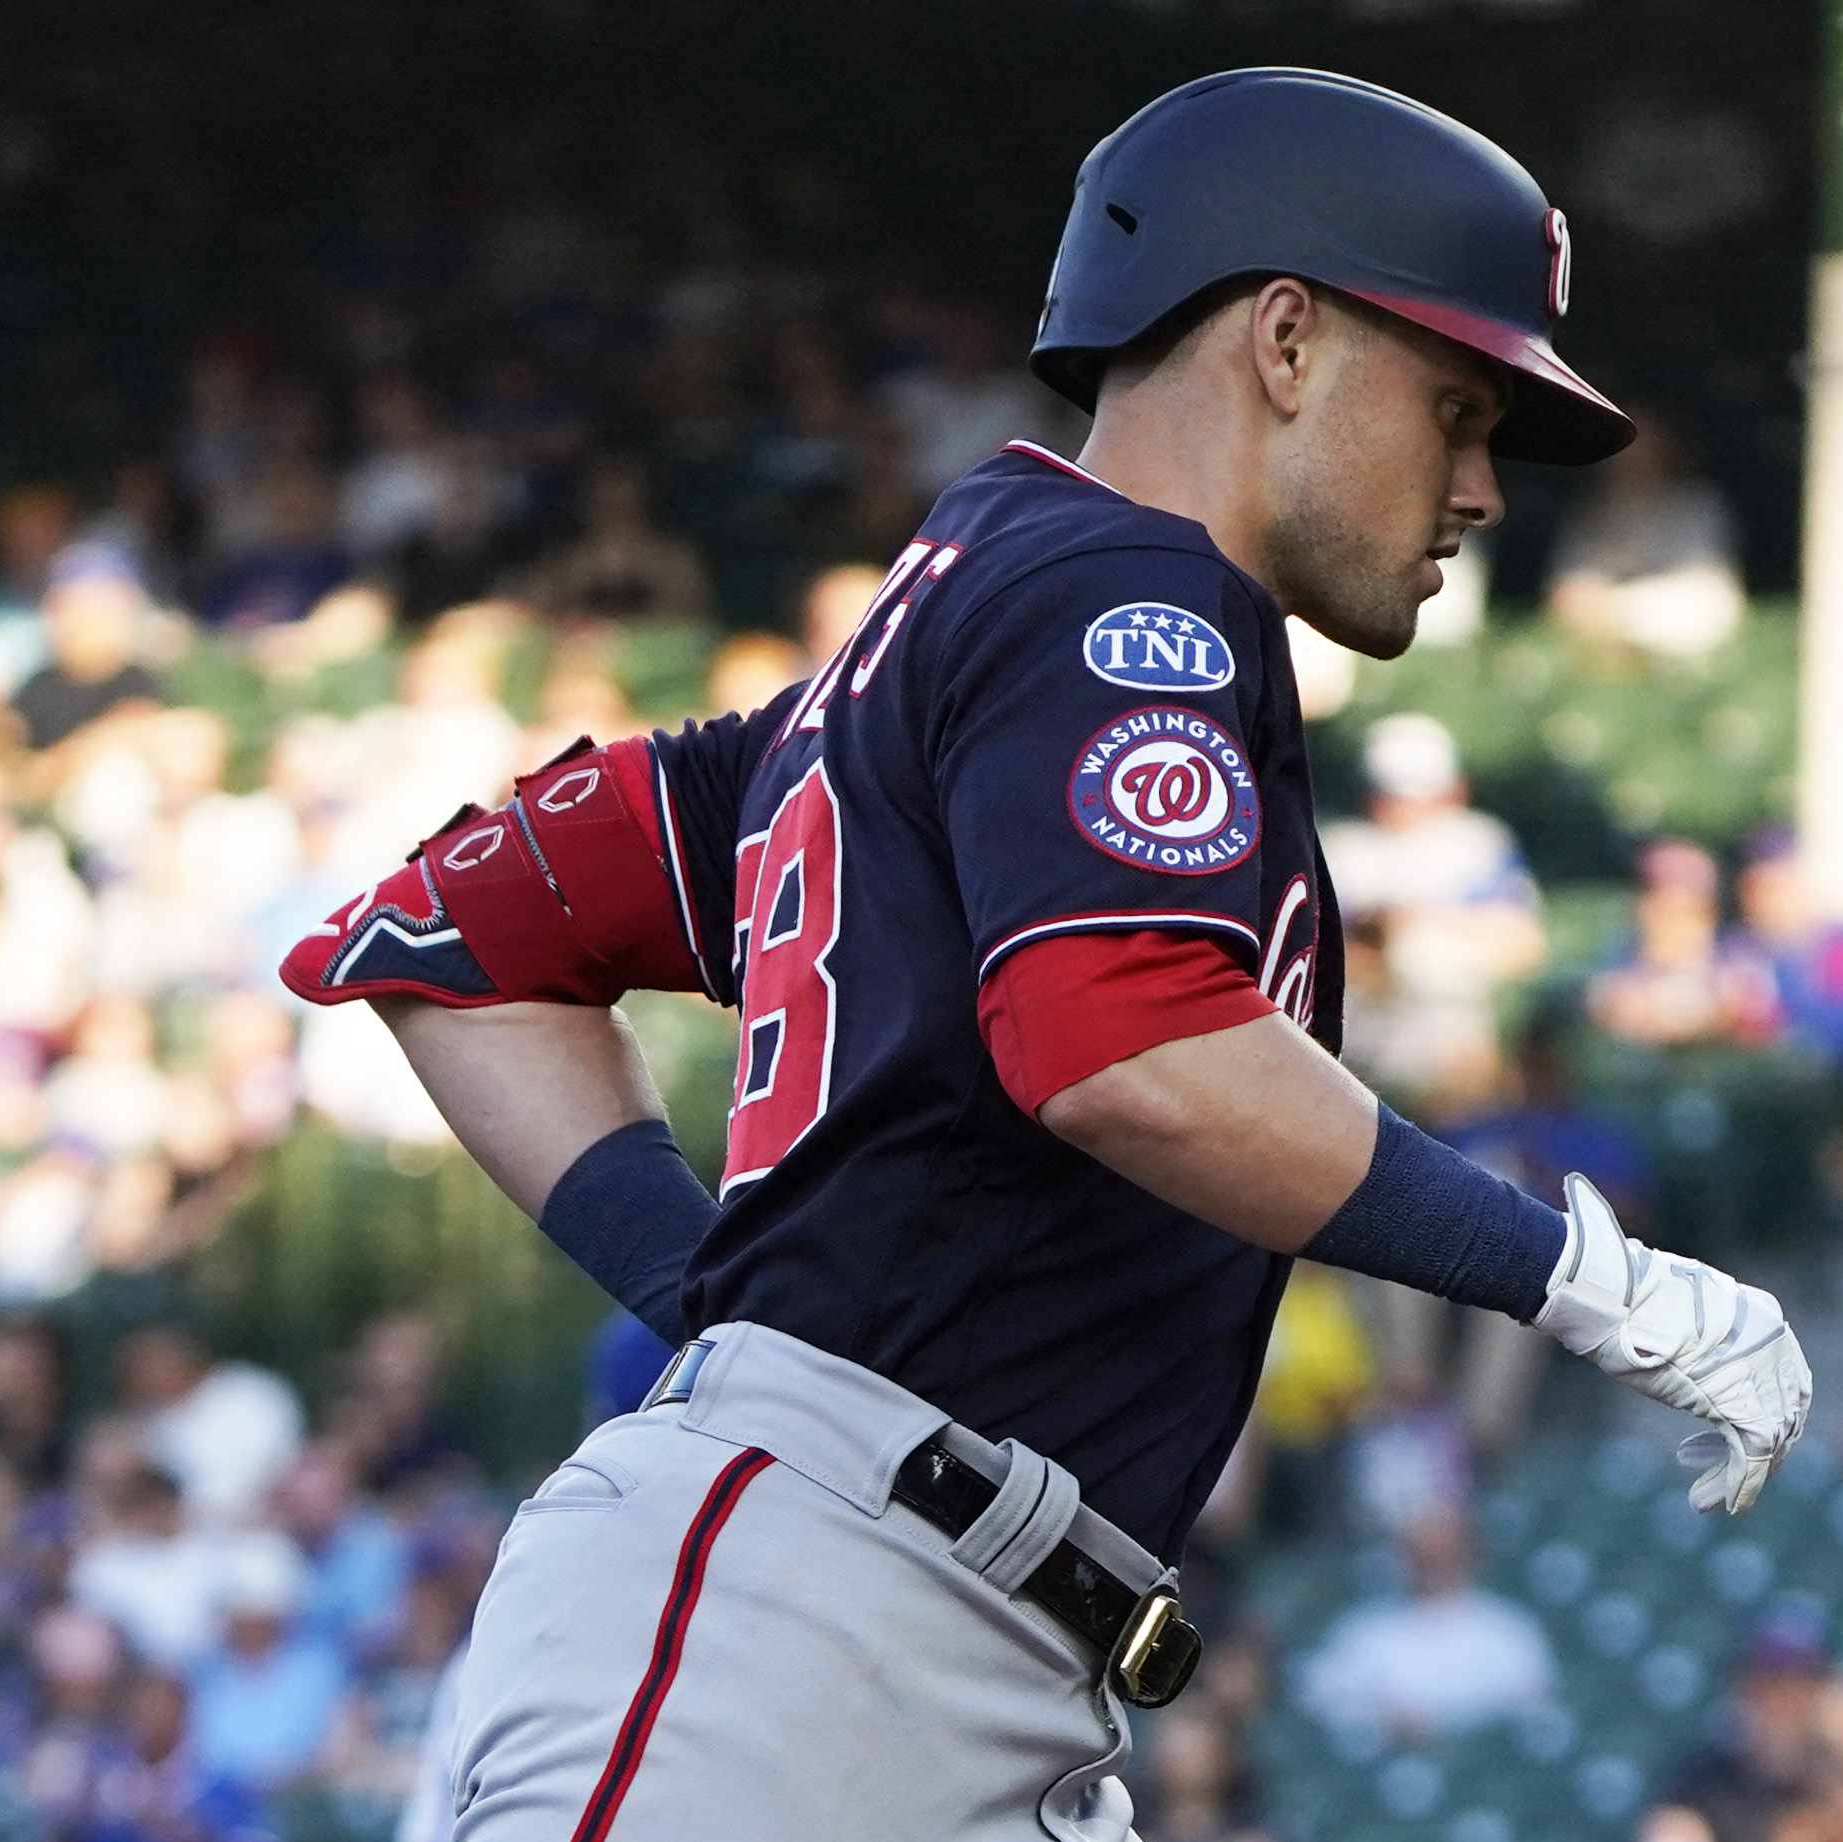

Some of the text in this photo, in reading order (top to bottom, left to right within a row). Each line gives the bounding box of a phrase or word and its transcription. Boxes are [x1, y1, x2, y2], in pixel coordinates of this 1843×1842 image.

[1096, 628, 1225, 681] TNL
[1080, 712, 1252, 788] WASHINGTON
[1122, 756, 1211, 826] W
[1091, 817, 1248, 866] NATIONALS
